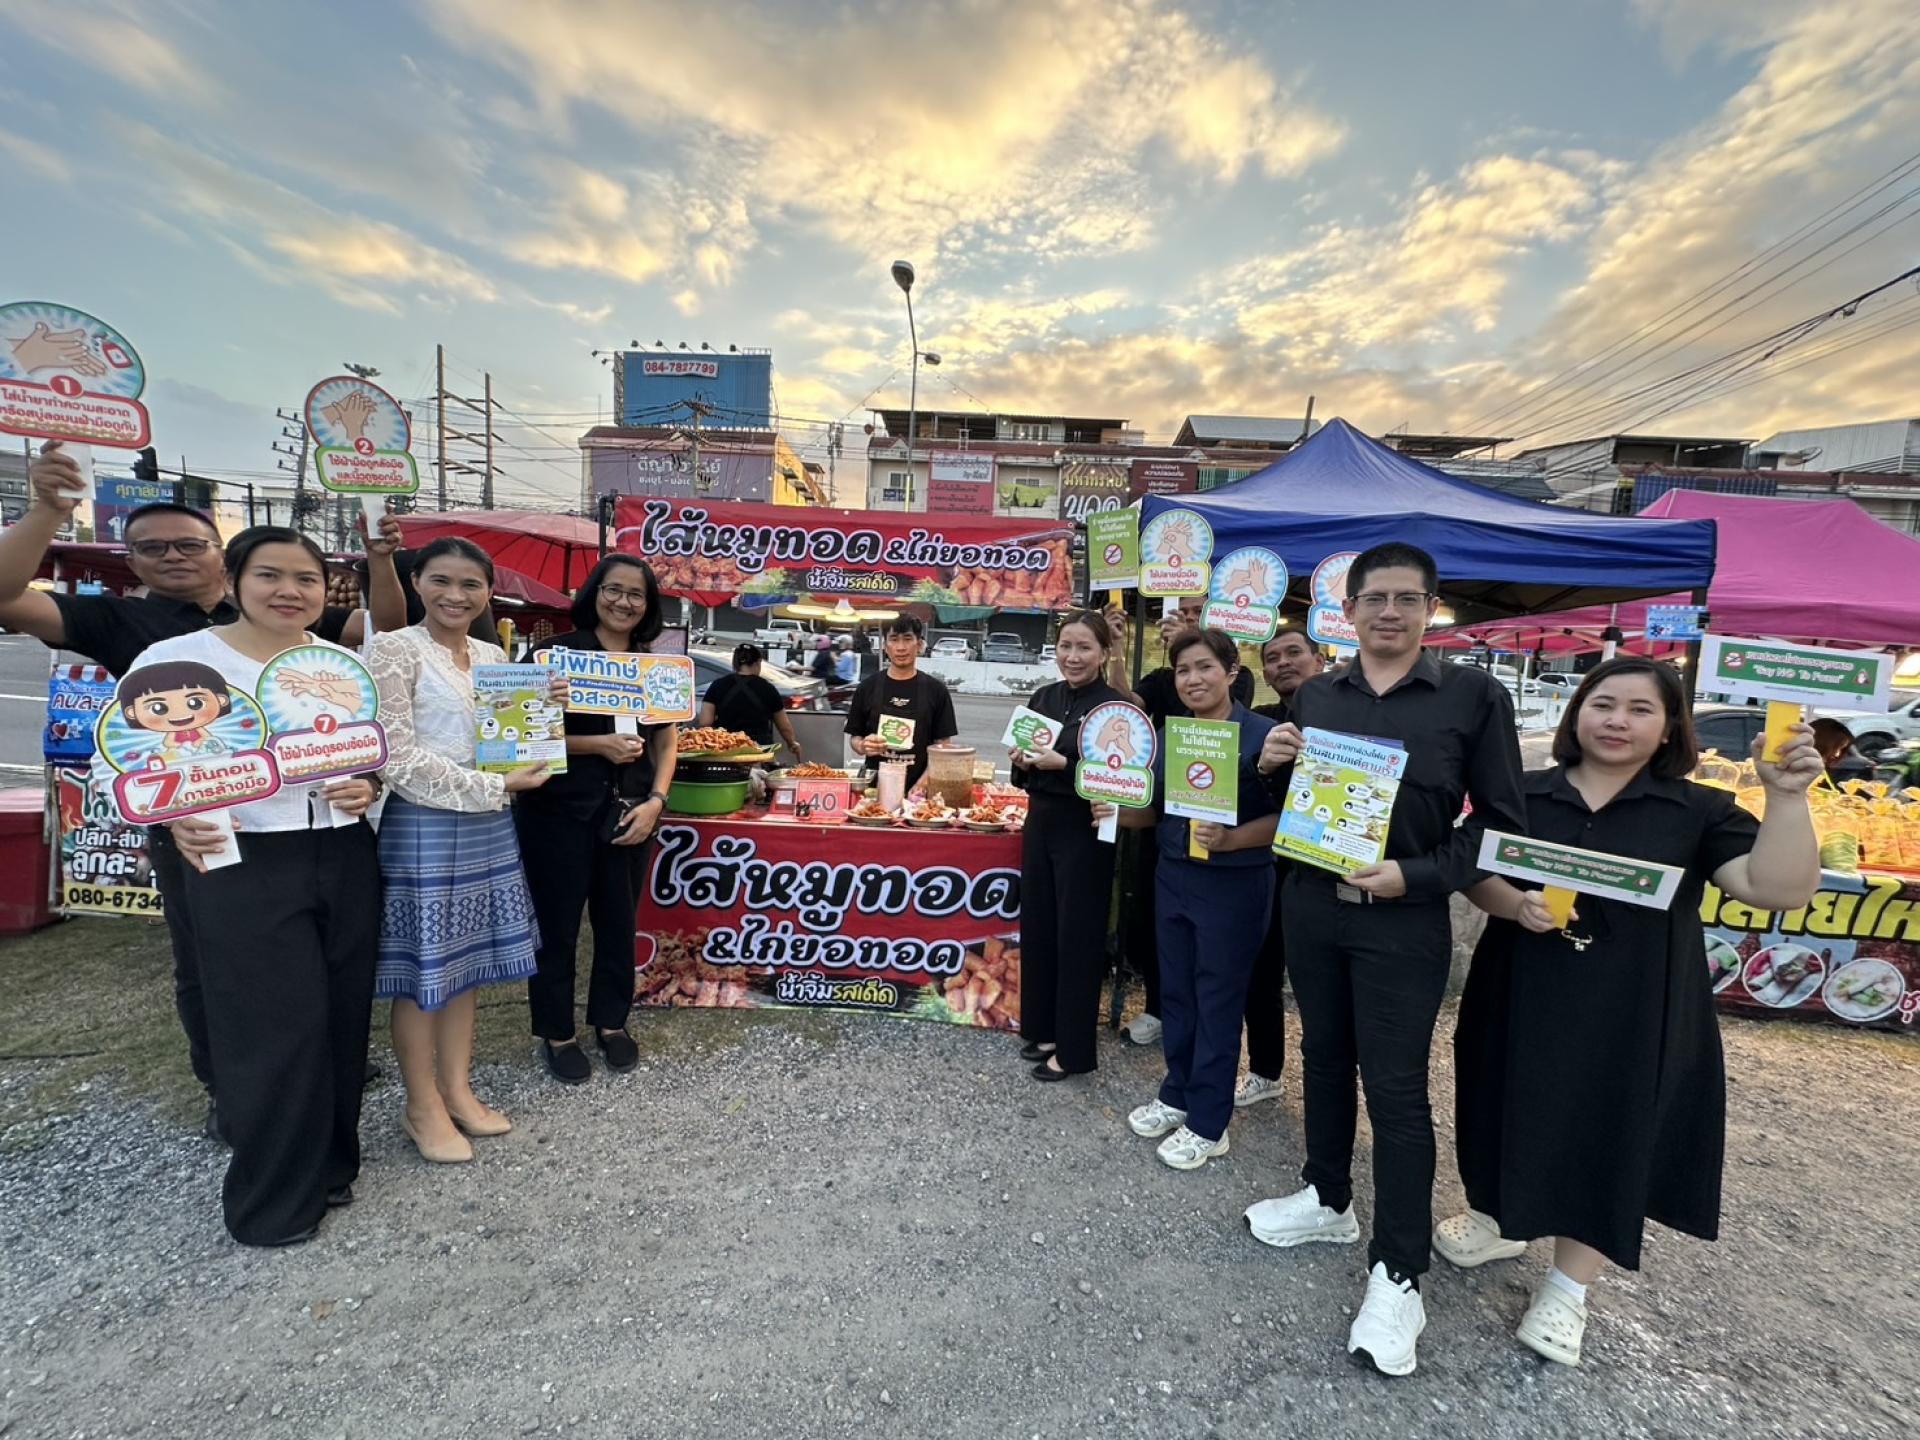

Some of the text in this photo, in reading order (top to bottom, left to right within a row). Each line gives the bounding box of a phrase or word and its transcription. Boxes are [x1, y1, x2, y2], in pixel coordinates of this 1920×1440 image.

[642, 501, 882, 572] ไส้หมูทอด
[807, 567, 898, 592] น้ำจิ้มรสเด็ด
[570, 689, 646, 710] อสะอาด
[277, 734, 379, 761] ใช้ฝ่ามือถูรอบข้อมือ
[135, 769, 183, 811] 7
[184, 776, 268, 802] การล้างมือ
[808, 792, 837, 812] 40
[72, 850, 137, 880] ลูกละ
[651, 825, 1022, 930] ไส้หมูทอด
[703, 914, 965, 974] &ไก่ยอทอด
[776, 970, 898, 1007] น้ำจิ้มรสเด็ด
